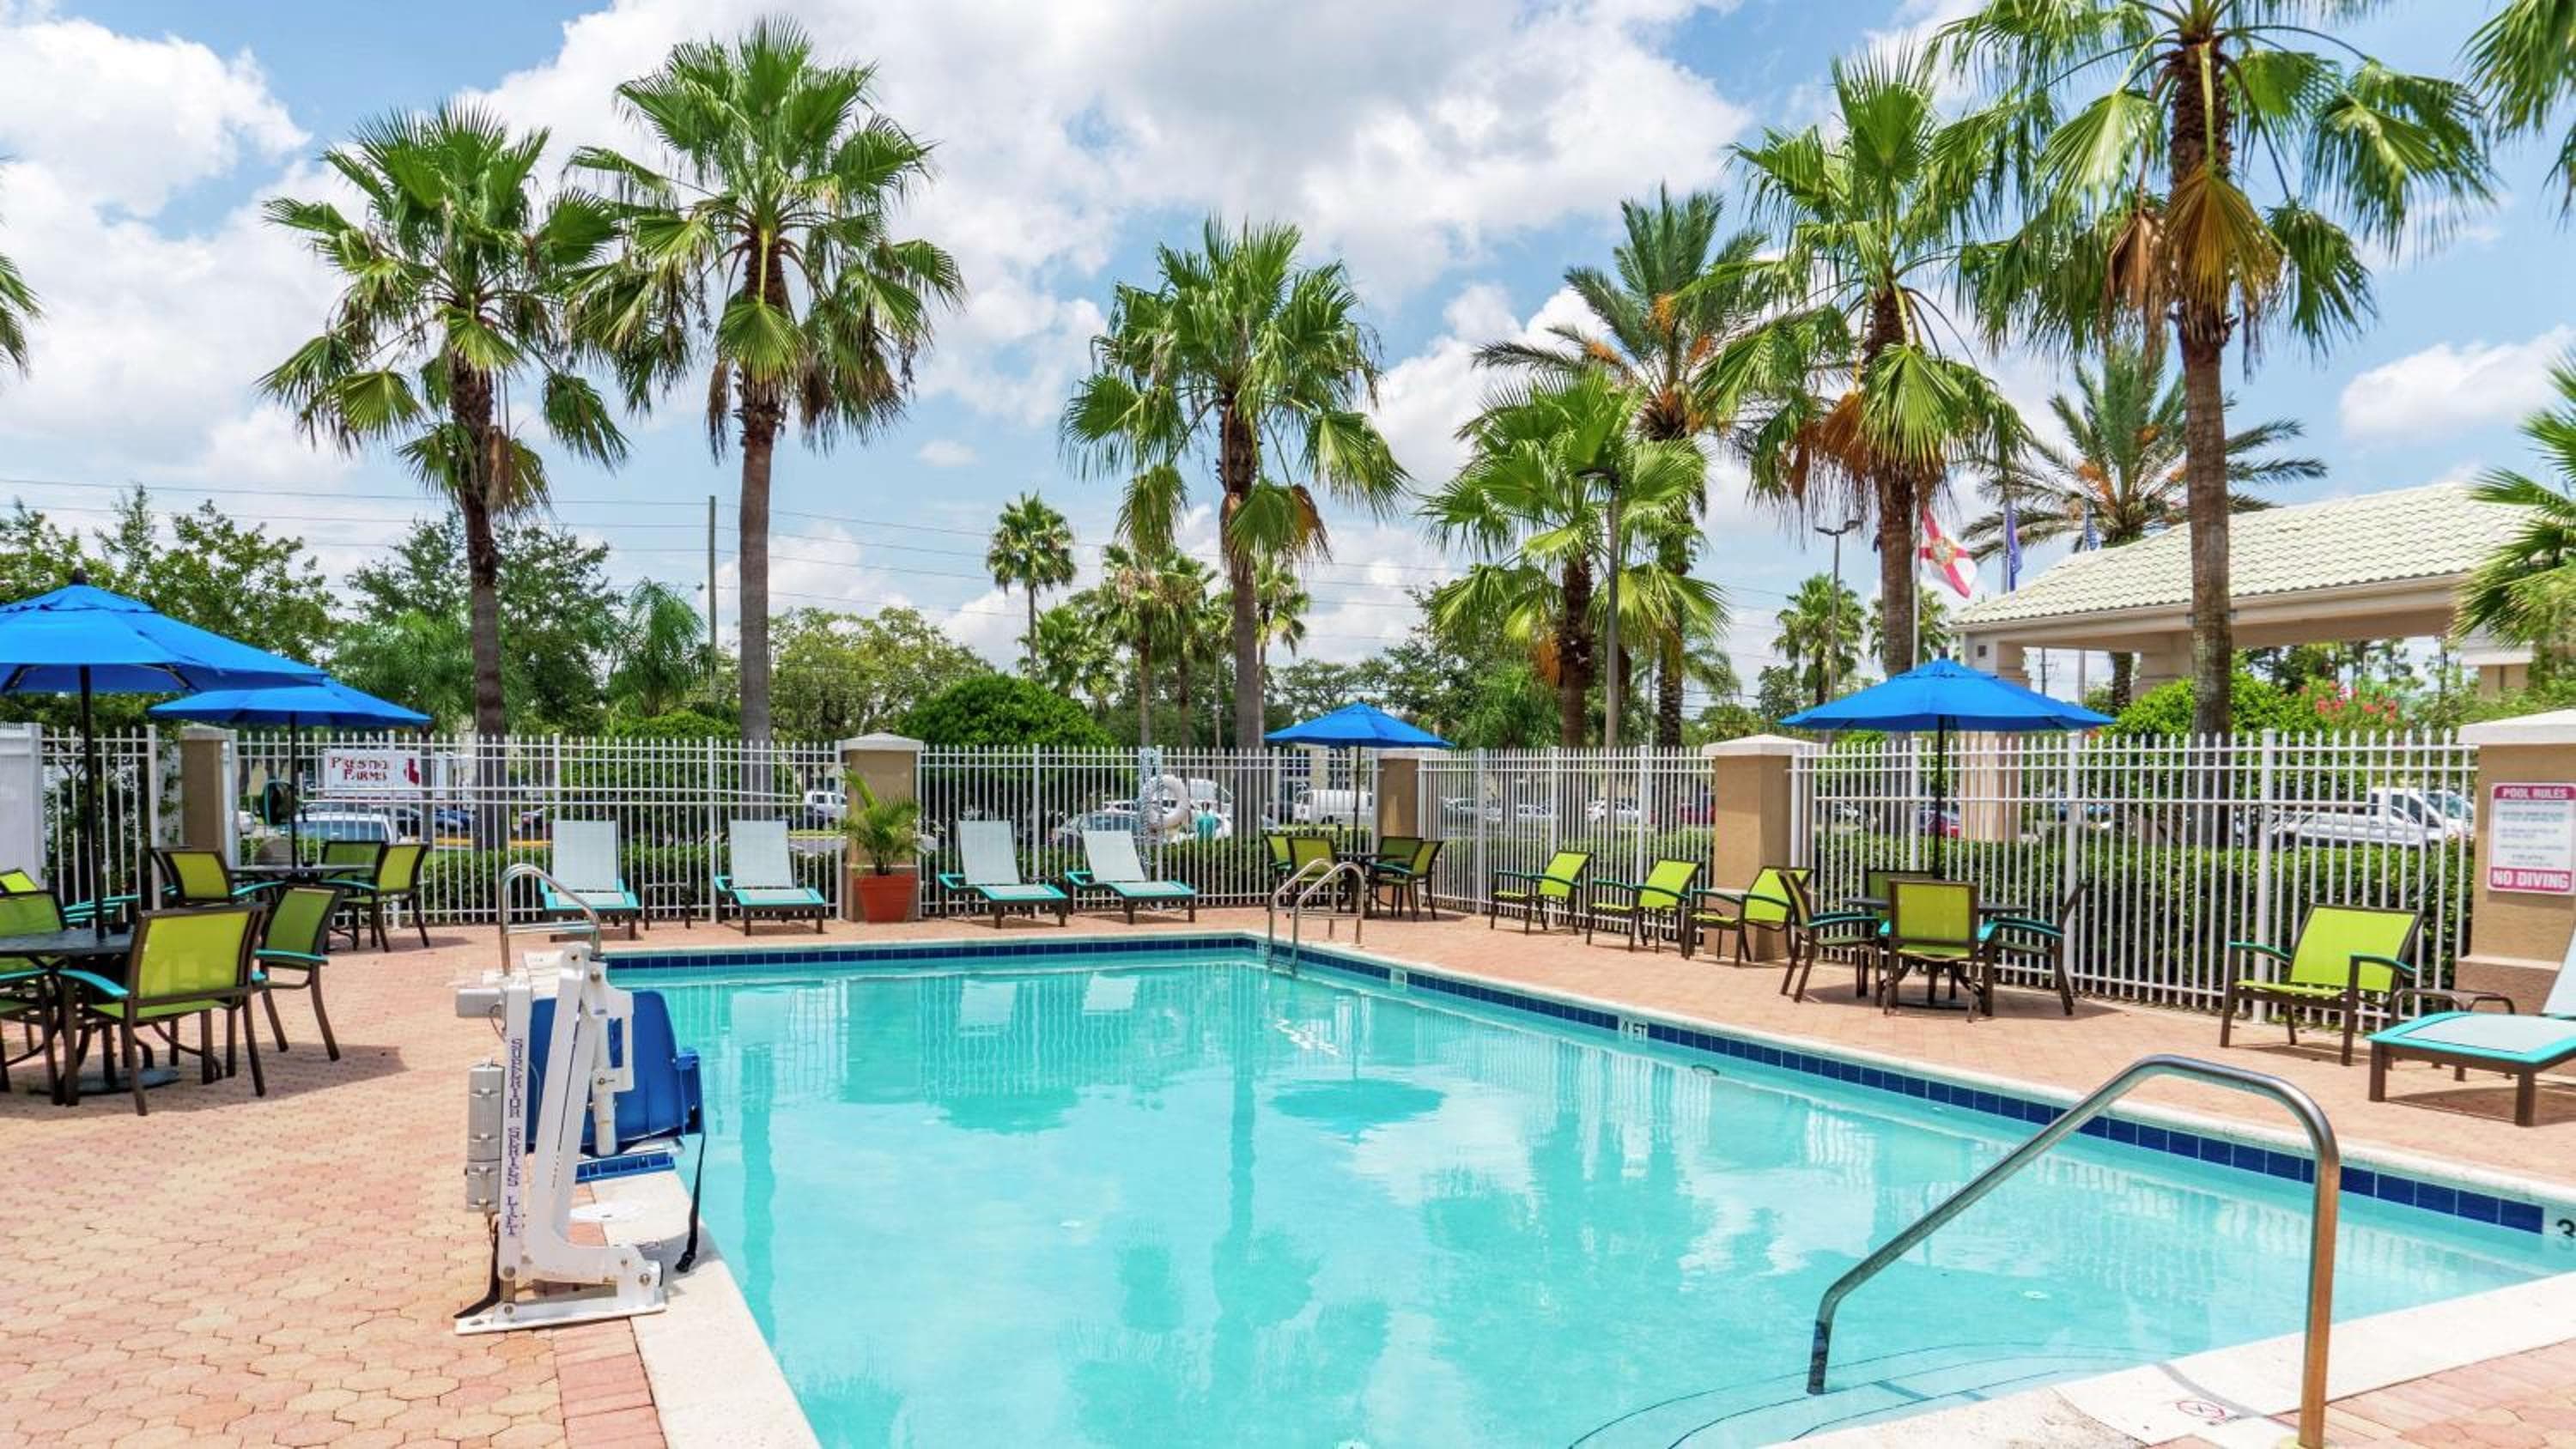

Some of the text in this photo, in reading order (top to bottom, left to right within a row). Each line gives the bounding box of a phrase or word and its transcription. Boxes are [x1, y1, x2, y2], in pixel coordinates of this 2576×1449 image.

[2502, 787, 2568, 799] POOL RULES
[2493, 870, 2570, 889] NO DIVING
[507, 1126, 521, 1187] SERIES
[506, 1194, 519, 1236] LIFT
[2555, 1217, 2576, 1239] 3
